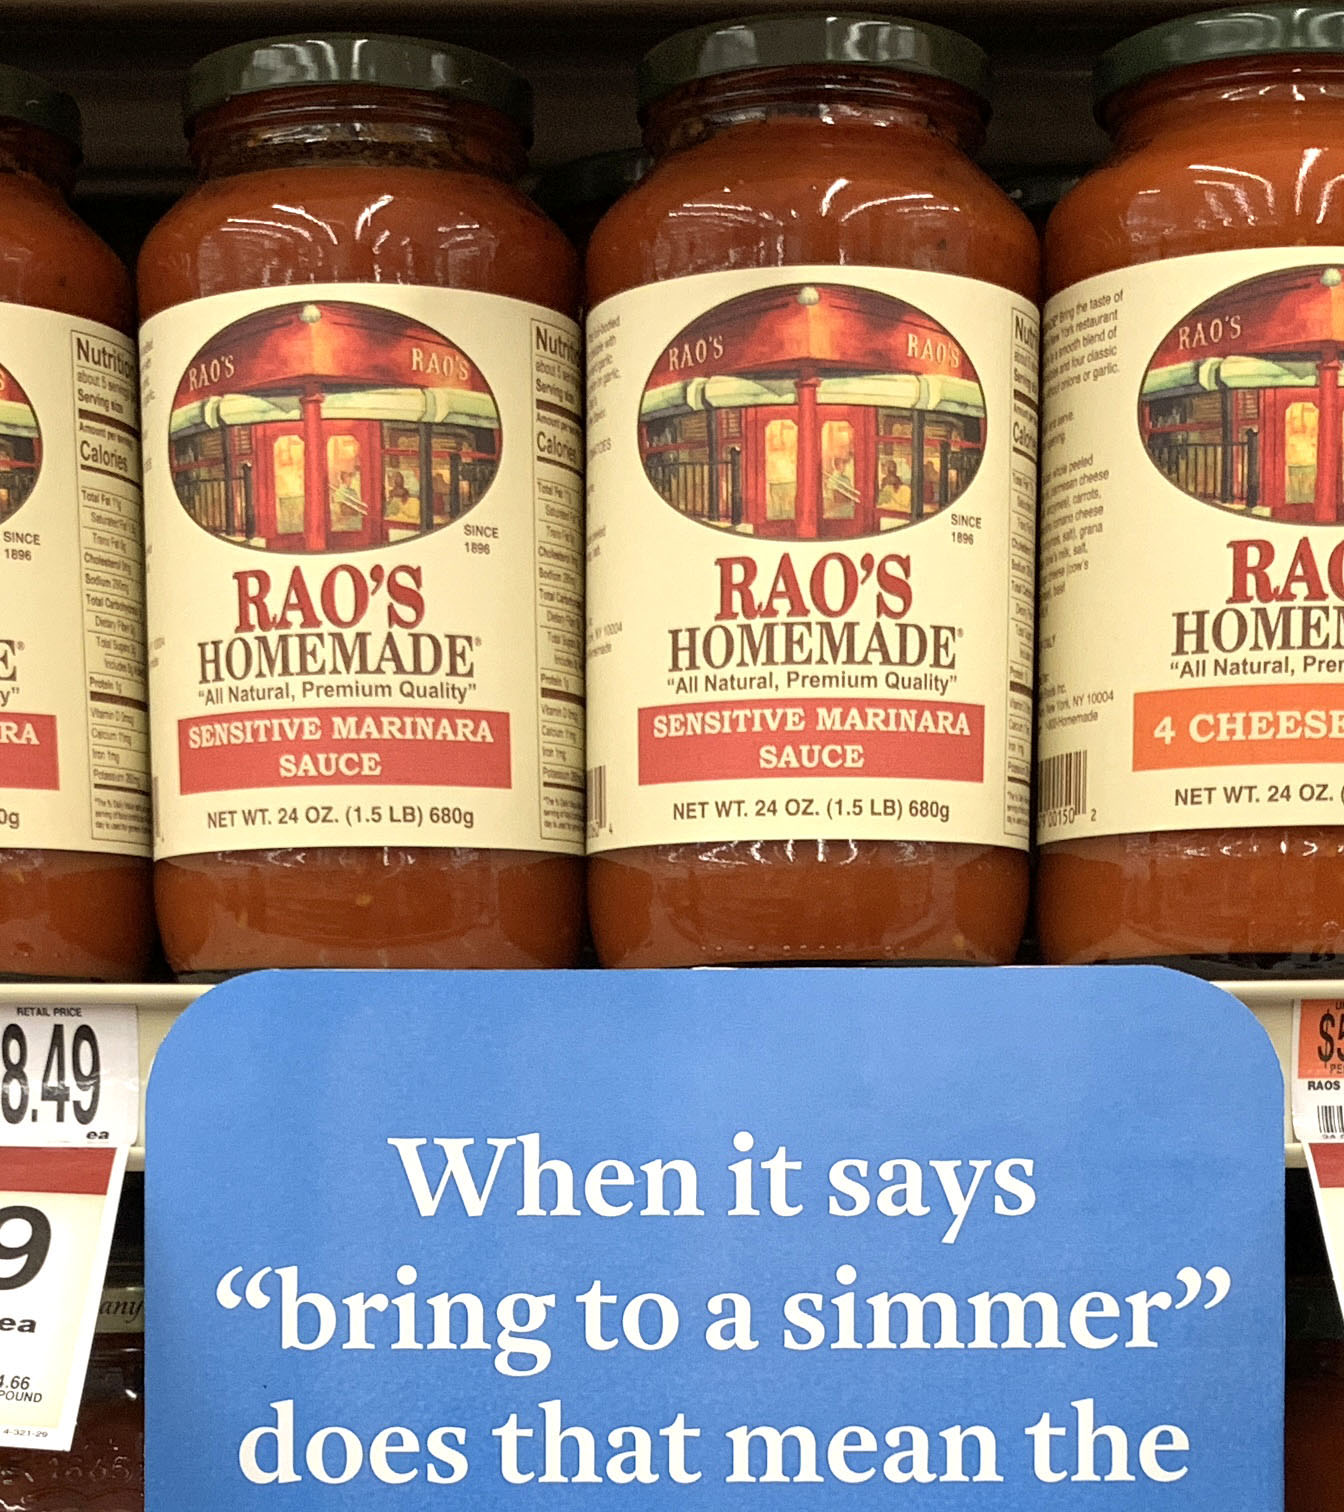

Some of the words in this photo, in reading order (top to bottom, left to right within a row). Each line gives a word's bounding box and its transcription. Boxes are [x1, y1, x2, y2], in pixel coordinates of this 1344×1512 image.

[232, 564, 425, 634] RAO'S
[714, 552, 912, 621] RAO'S
[198, 633, 475, 683] HOMEMADE
[668, 621, 956, 673] HOMEMADE
[1154, 718, 1176, 744] 4
[0, 1023, 100, 1125] 8.49
[1308, 1081, 1341, 1090] RAOS
[387, 1131, 704, 1220] When
[727, 1131, 802, 1219] it
[827, 1155, 1036, 1244] says
[576, 1287, 680, 1352] to
[705, 1290, 758, 1351] a
[238, 1400, 468, 1484] does
[491, 1402, 700, 1484] that
[726, 1419, 1001, 1484] mean
[1024, 1399, 1189, 1484] the
